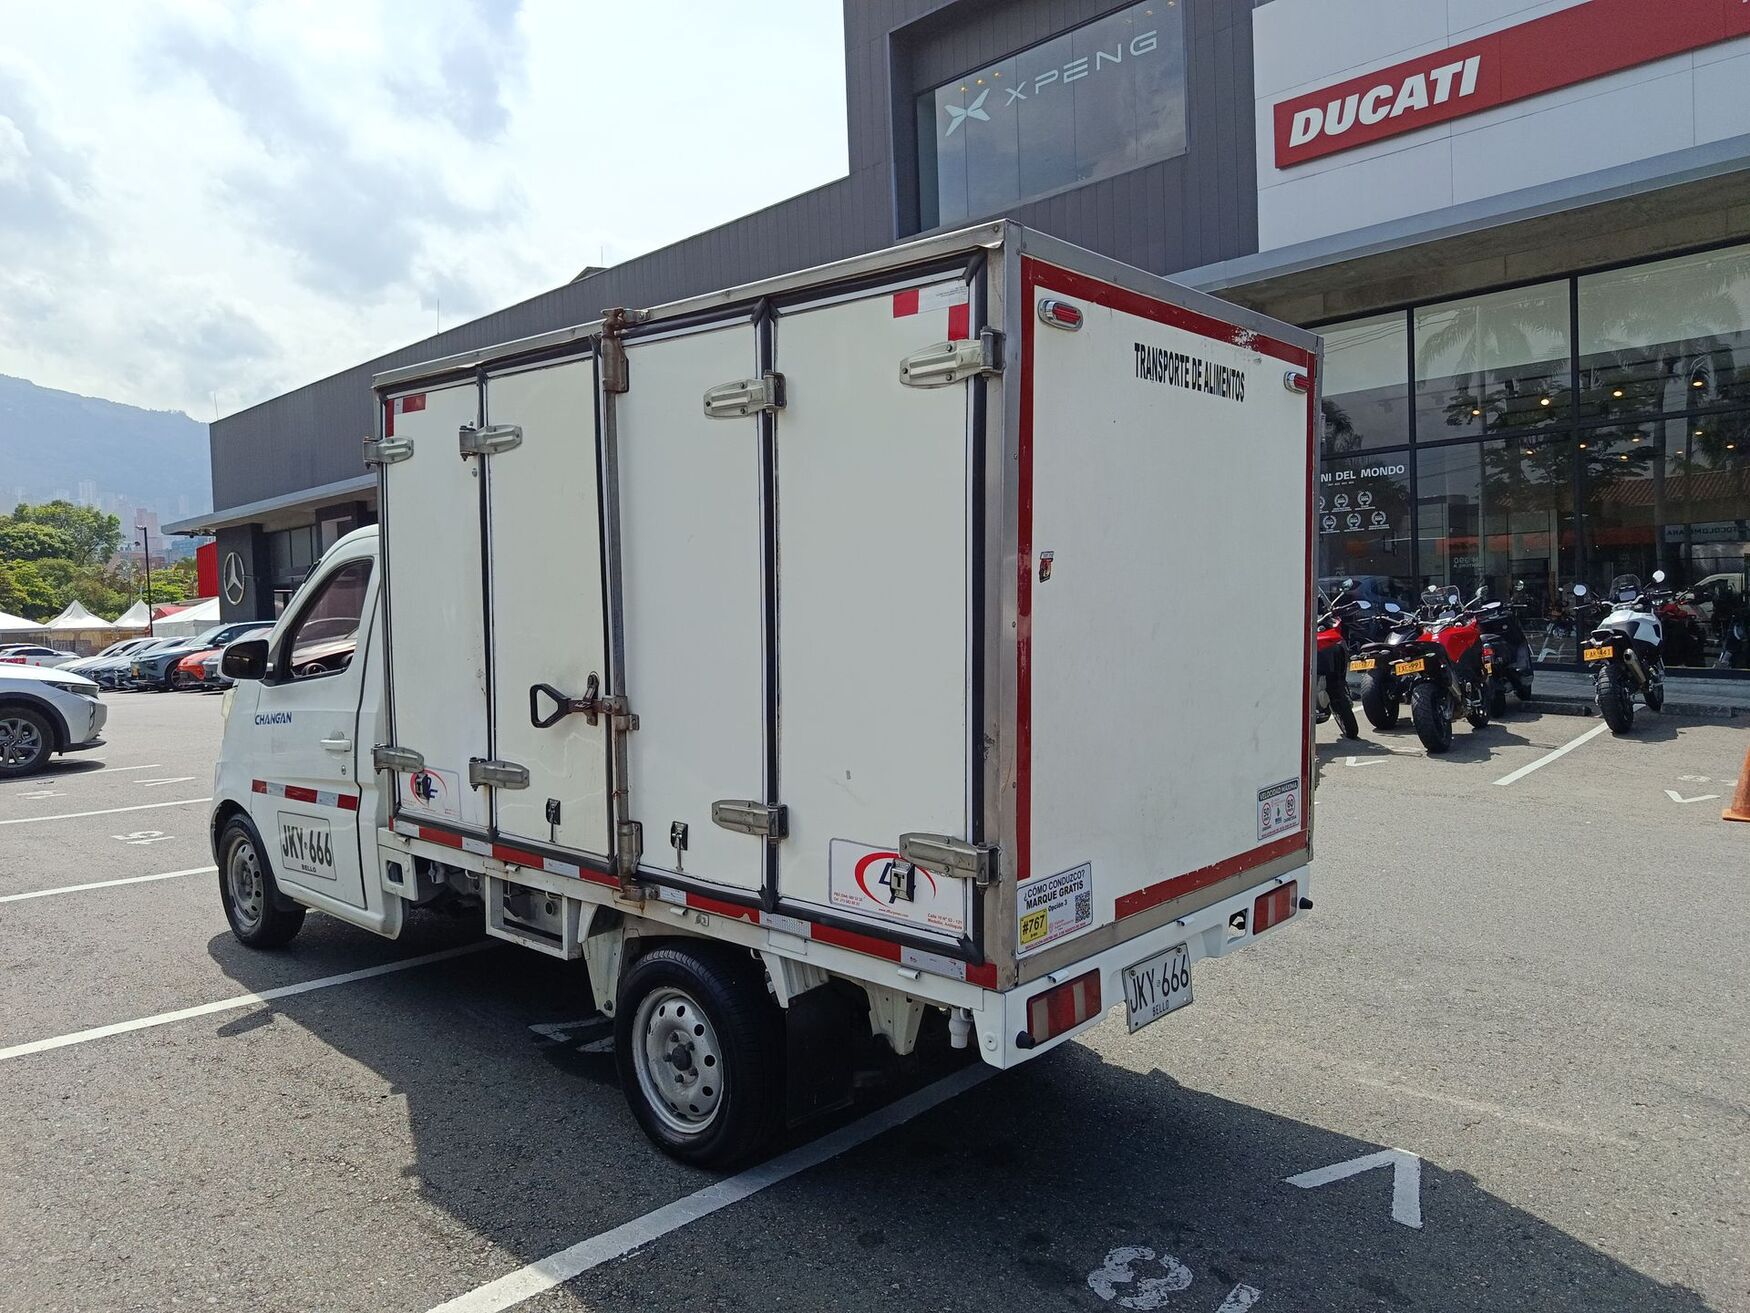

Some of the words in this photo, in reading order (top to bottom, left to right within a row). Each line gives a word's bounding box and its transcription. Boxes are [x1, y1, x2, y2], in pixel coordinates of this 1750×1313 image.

[1004, 30, 1157, 107] XPENG
[1289, 55, 1481, 148] DUCATI
[1134, 342, 1190, 389] TRANSPORTE
[1191, 357, 1202, 392] DE
[1203, 361, 1245, 403] ALIMENTOS
[1335, 471, 1356, 481] DEL
[1360, 464, 1405, 478] MONDO
[255, 711, 292, 725] CHANGAN
[301, 863, 317, 873] BELLO
[1048, 869, 1086, 890] CONDUZCO?
[1026, 890, 1058, 910] MARQUE
[1058, 880, 1084, 898] GRATIS
[1022, 914, 1045, 936] #767
[1152, 999, 1170, 1017] BELLO
